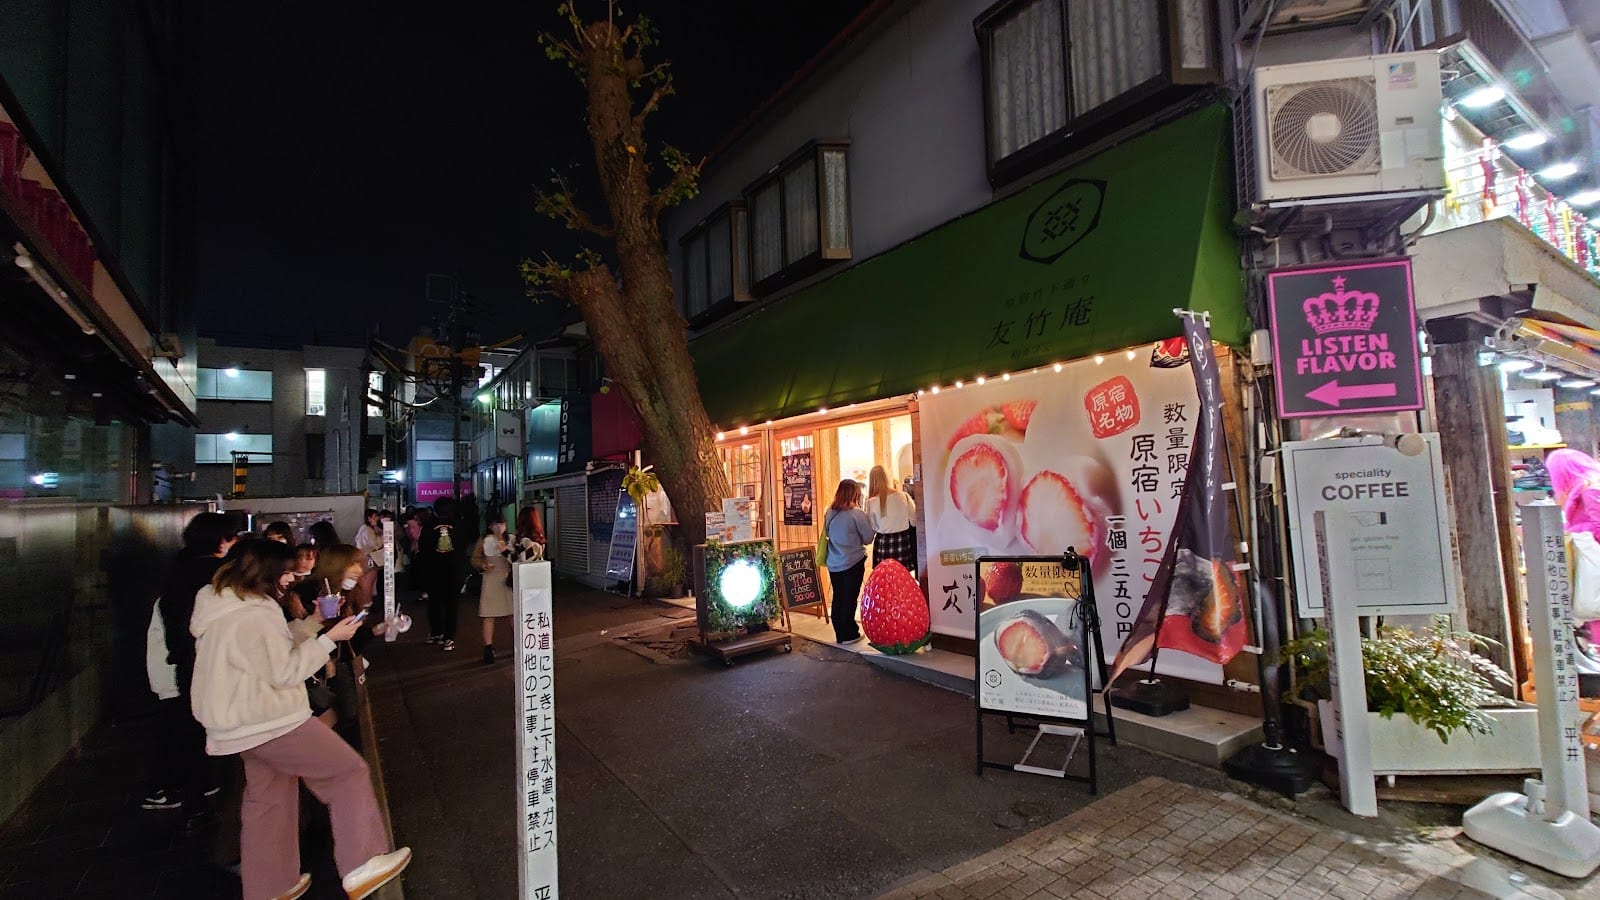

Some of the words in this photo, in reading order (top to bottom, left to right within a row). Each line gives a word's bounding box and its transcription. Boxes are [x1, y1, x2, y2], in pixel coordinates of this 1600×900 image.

[987, 296, 1094, 348] 友竹庵
[1302, 333, 1389, 357] LISTEN
[1296, 351, 1396, 375] FLAVOR
[1092, 382, 1126, 411] 原宿
[1098, 401, 1134, 430] 名物
[1163, 402, 1188, 499] 数量限定
[1335, 468, 1392, 480] speciality
[1321, 482, 1409, 502] COFFEE
[788, 572, 805, 581] OPEN
[791, 584, 811, 595] CLOSE
[537, 611, 555, 849] 私道につき上下水道、ガス
[1565, 727, 1579, 761] 平井
